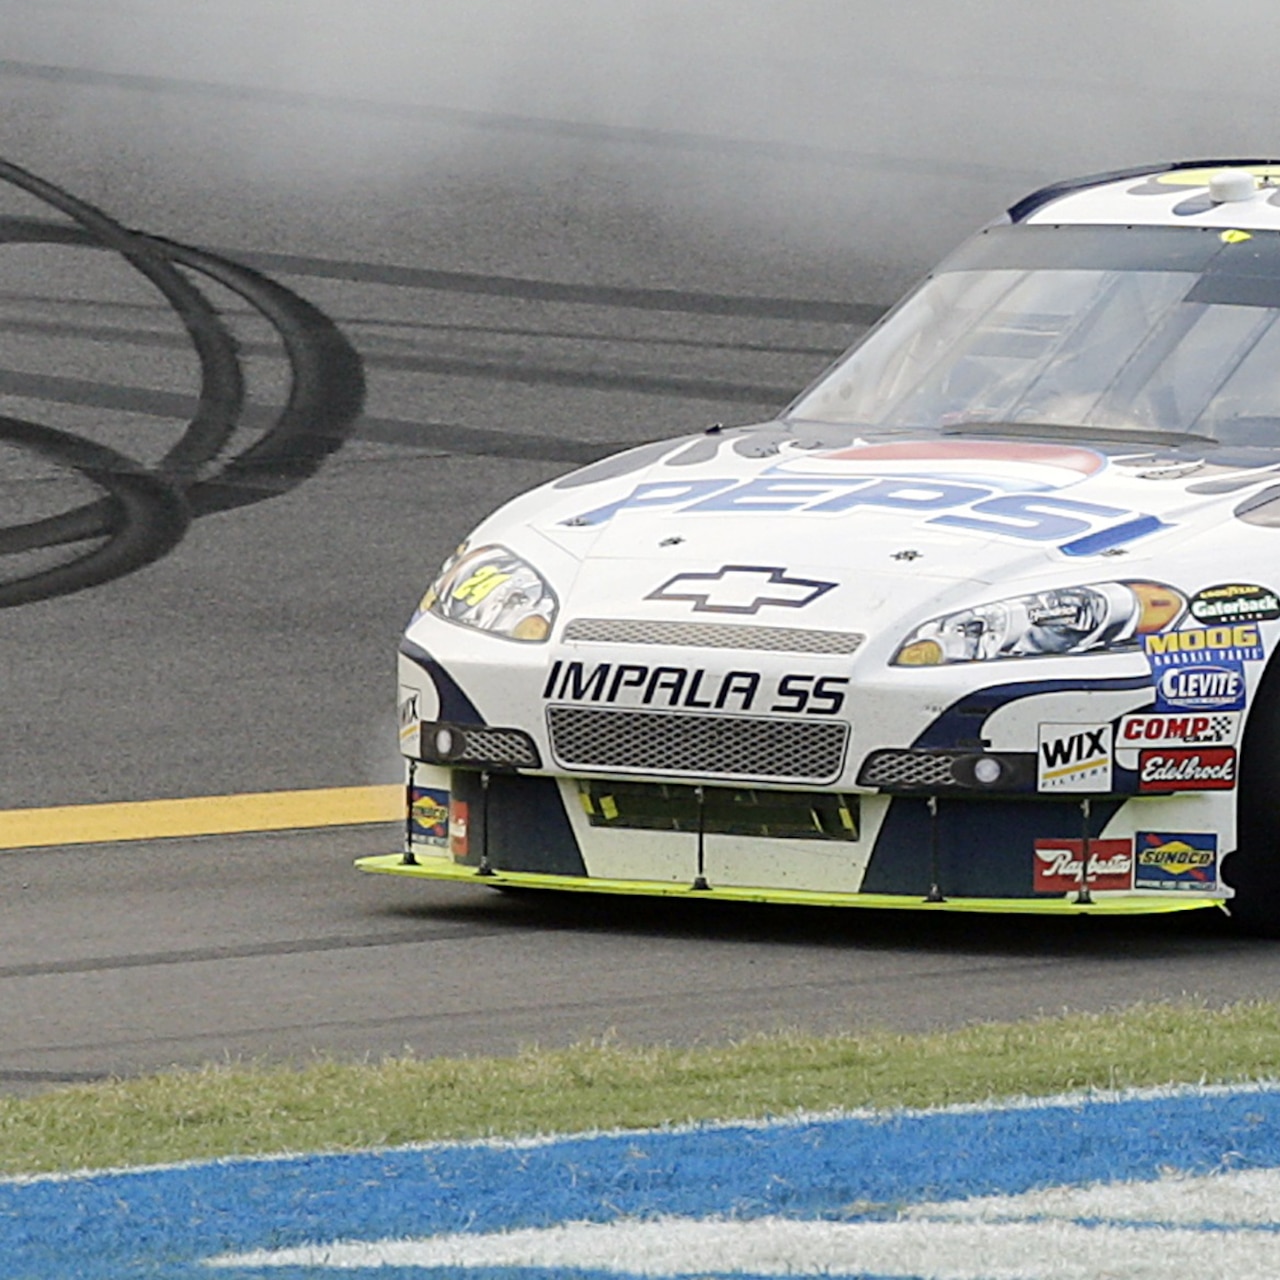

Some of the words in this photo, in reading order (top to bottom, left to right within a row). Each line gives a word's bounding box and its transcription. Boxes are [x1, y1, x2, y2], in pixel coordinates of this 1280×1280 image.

[556, 477, 1177, 558] PEPSI
[452, 566, 512, 608] 24
[1192, 595, 1279, 617] Gatorback
[1145, 625, 1258, 656] MOOG
[543, 660, 757, 711] IMPALA
[772, 676, 851, 716] SS
[1162, 668, 1240, 699] CLEVITE
[1124, 717, 1209, 740] COMP
[1042, 726, 1110, 769] WIX
[1141, 755, 1234, 782] Edelbrock
[1142, 850, 1211, 865] SUNOCO
